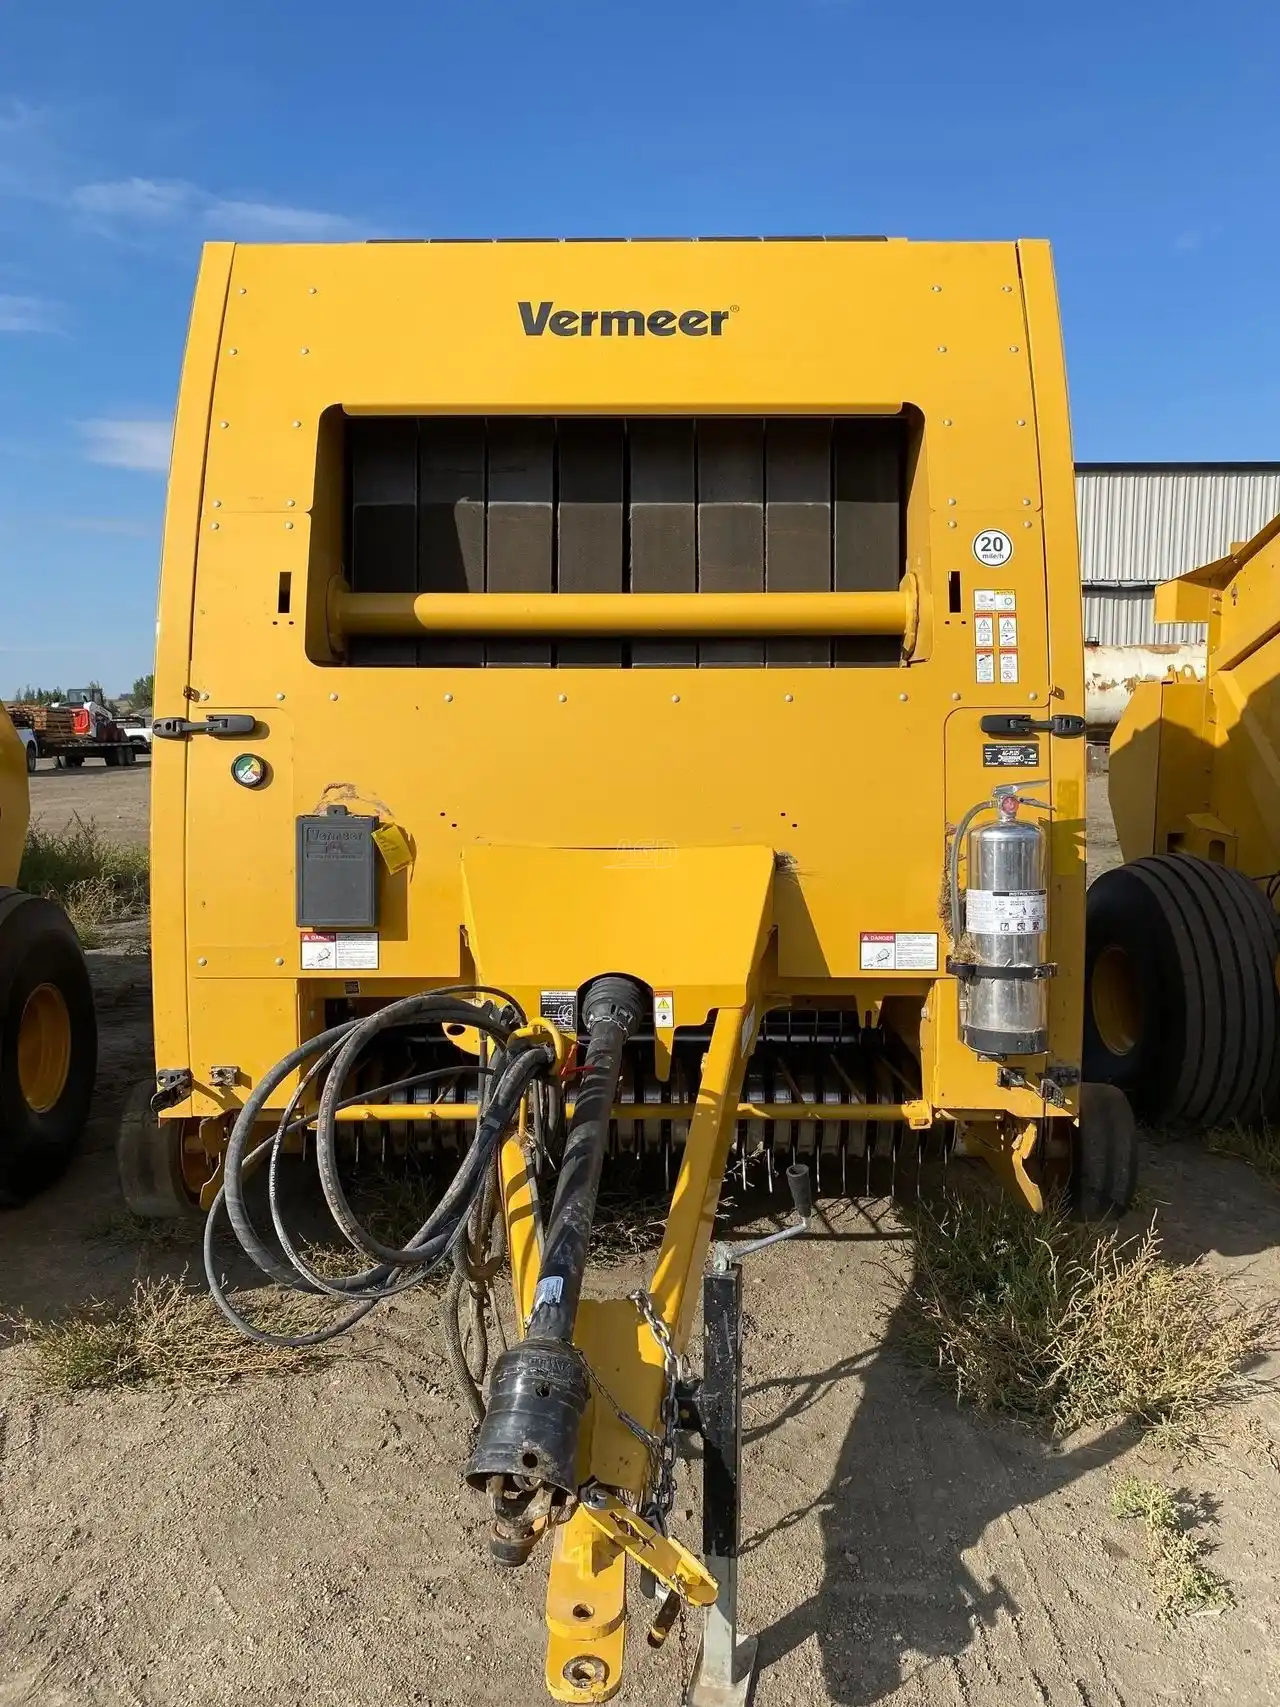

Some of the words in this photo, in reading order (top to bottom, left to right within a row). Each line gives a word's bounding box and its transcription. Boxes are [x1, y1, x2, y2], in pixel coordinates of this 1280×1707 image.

[518, 301, 729, 336] Vermeer
[981, 536, 1003, 551] 20
[311, 829, 363, 841] Vermeer
